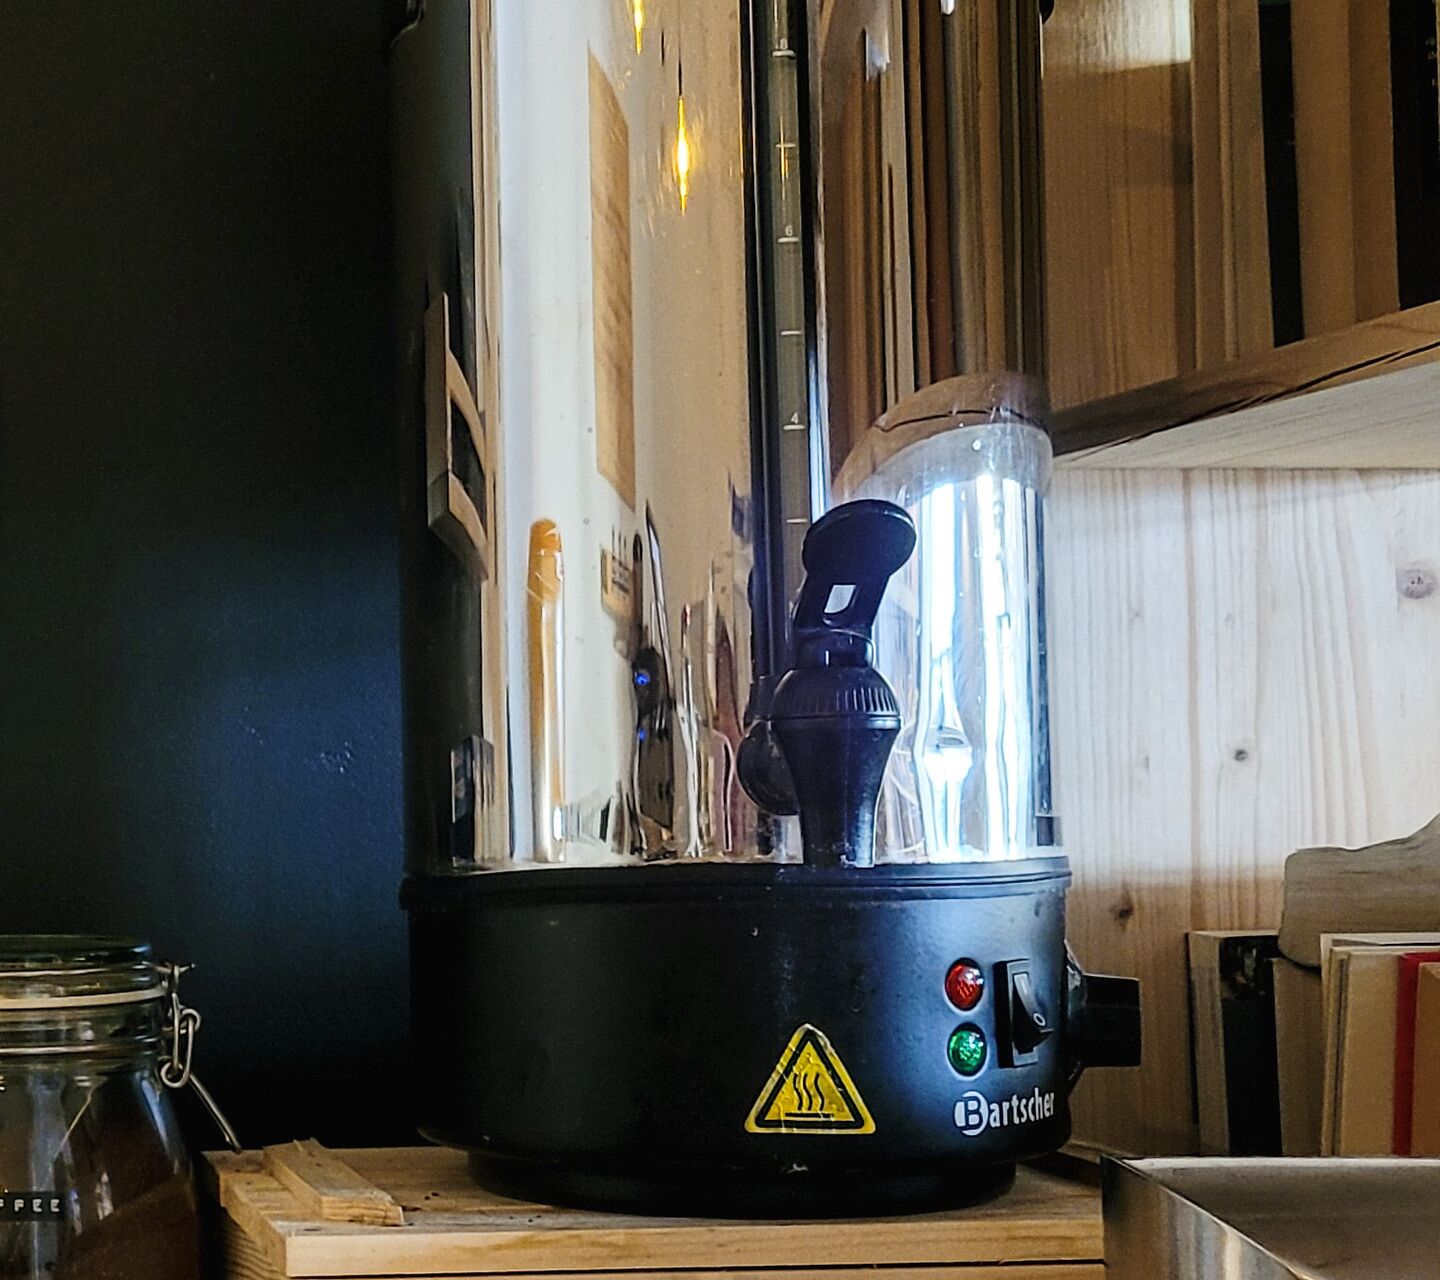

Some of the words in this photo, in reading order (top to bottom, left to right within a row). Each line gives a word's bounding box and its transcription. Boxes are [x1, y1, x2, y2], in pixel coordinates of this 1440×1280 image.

[785, 224, 793, 237] 6
[790, 412, 799, 424] 4
[954, 1087, 1055, 1136] Bartscher
